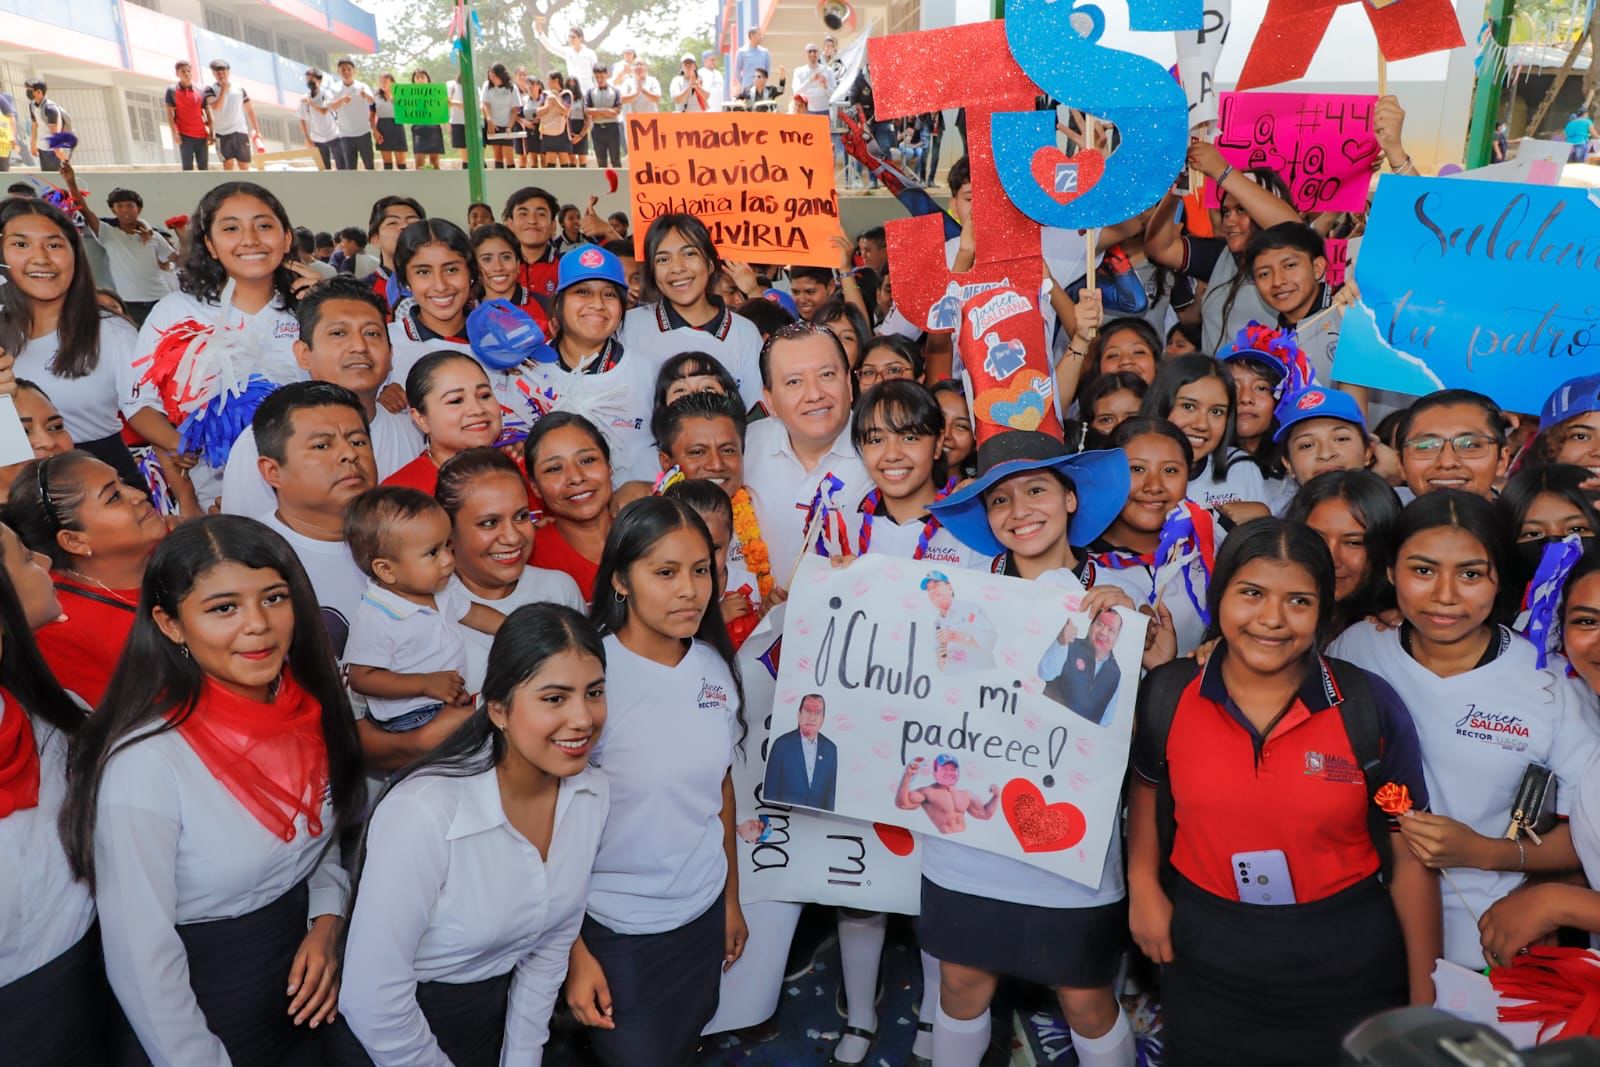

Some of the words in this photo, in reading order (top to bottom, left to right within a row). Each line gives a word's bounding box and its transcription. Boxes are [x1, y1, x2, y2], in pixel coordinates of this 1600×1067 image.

[1295, 101, 1371, 135] #44
[630, 119, 666, 151] Mi
[675, 122, 769, 148] madre
[780, 127, 814, 146] me
[721, 155, 788, 186] vida
[800, 165, 814, 189] y
[636, 191, 732, 220] Saldaña
[741, 189, 779, 214] las
[815, 596, 931, 699] ¡Chulo
[979, 680, 1021, 714] mi
[1455, 703, 1522, 728] Javier
[1470, 718, 1530, 738] SALDAÑA
[900, 711, 1068, 788] padreee!
[1456, 728, 1493, 741] RECTOR
